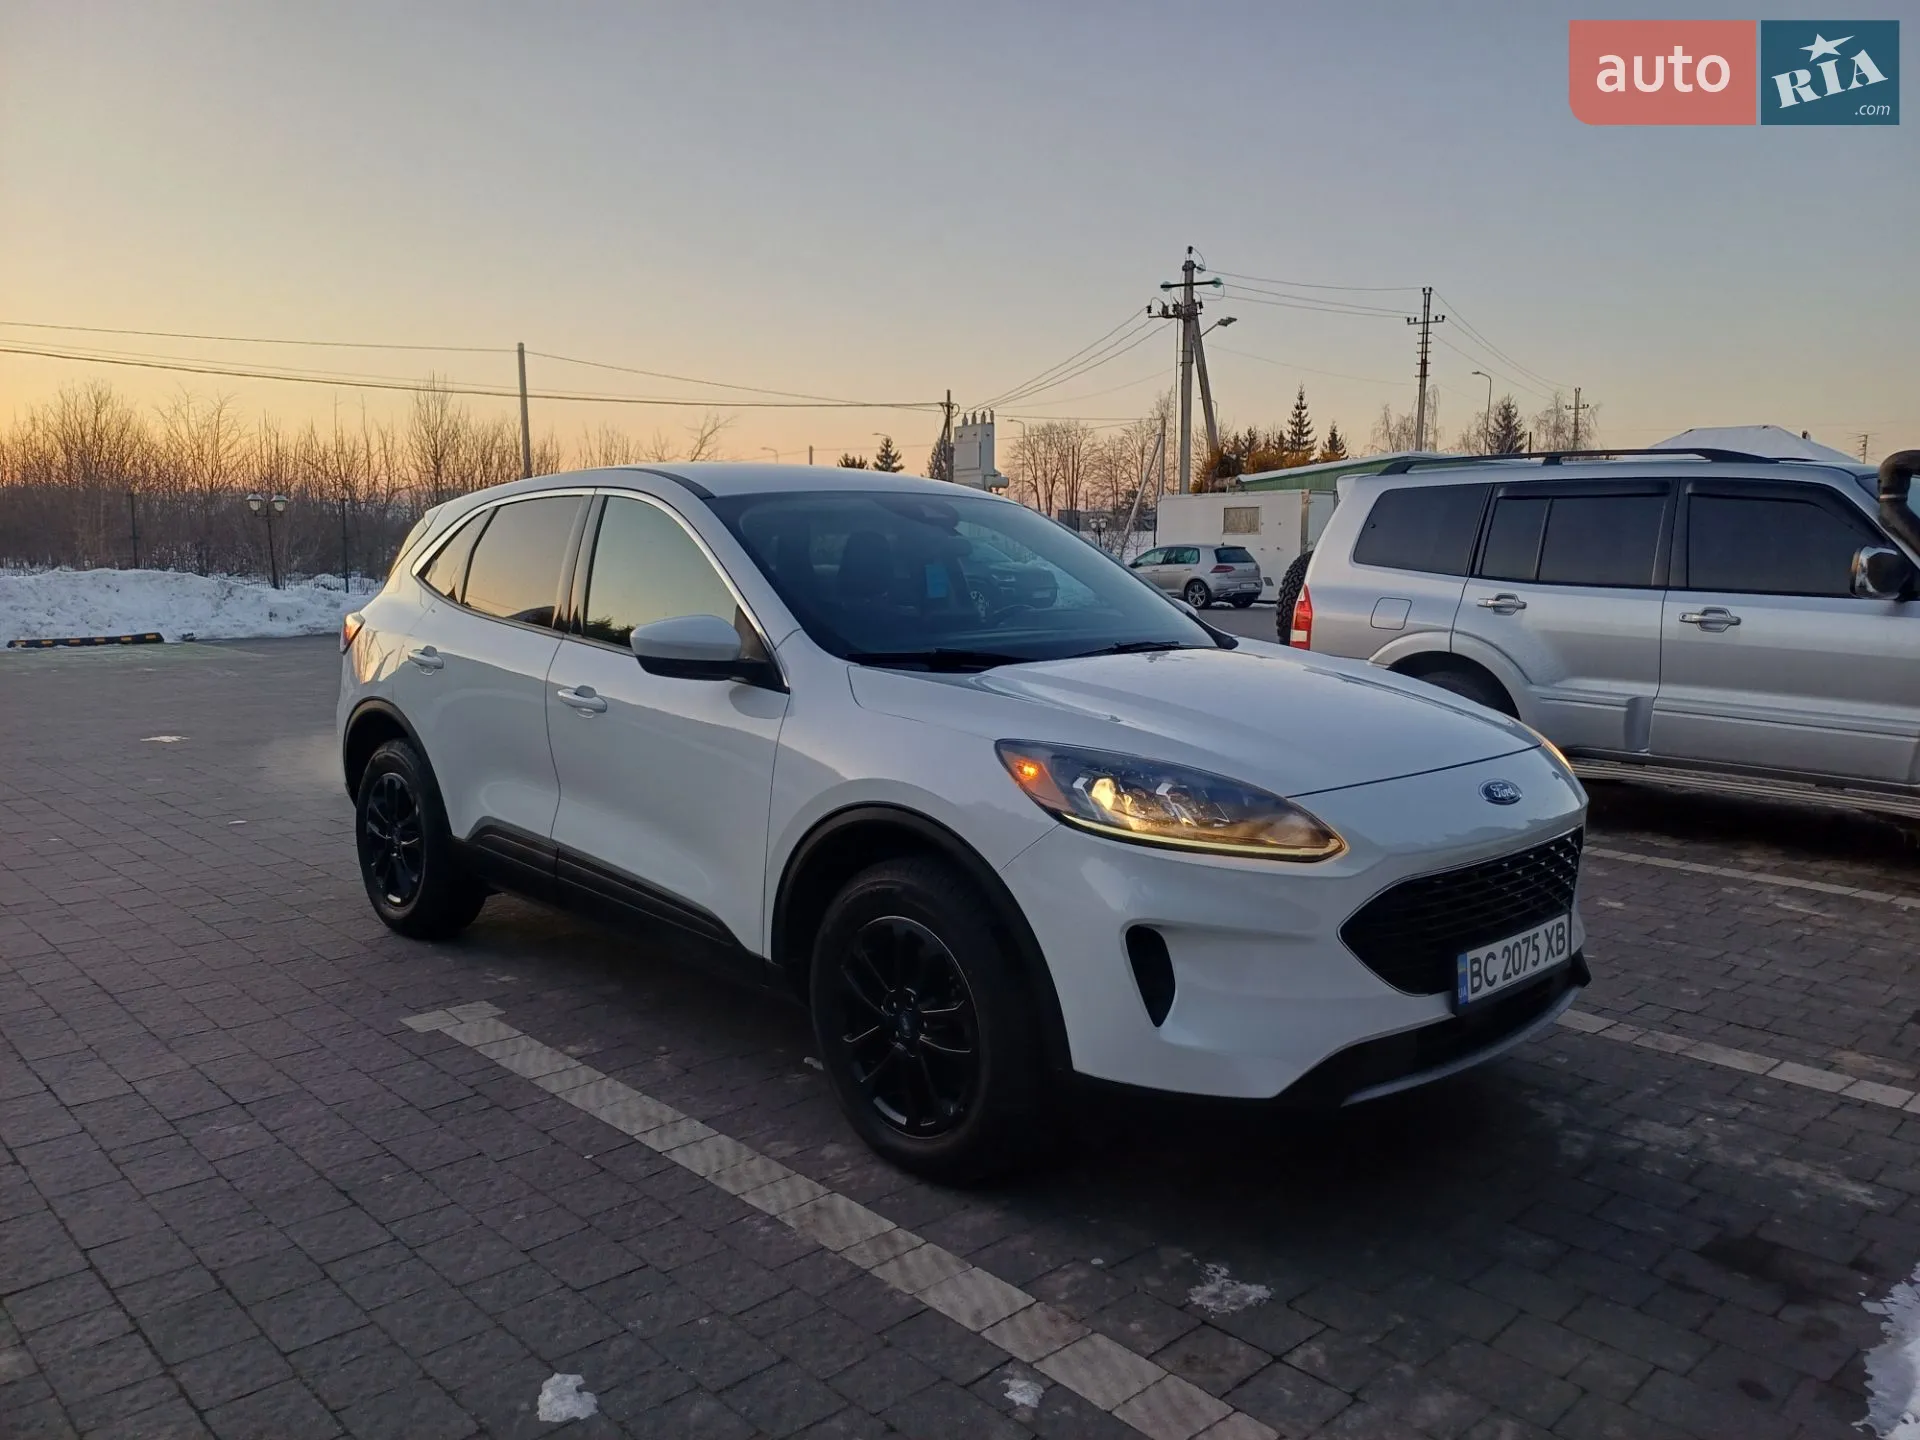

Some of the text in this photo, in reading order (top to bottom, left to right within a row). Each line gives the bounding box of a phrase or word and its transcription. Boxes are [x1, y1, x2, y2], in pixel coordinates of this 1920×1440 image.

[1489, 783, 1516, 798] Ford
[1469, 921, 1567, 995] BC 2075 XB
[1458, 984, 1468, 998] UA
